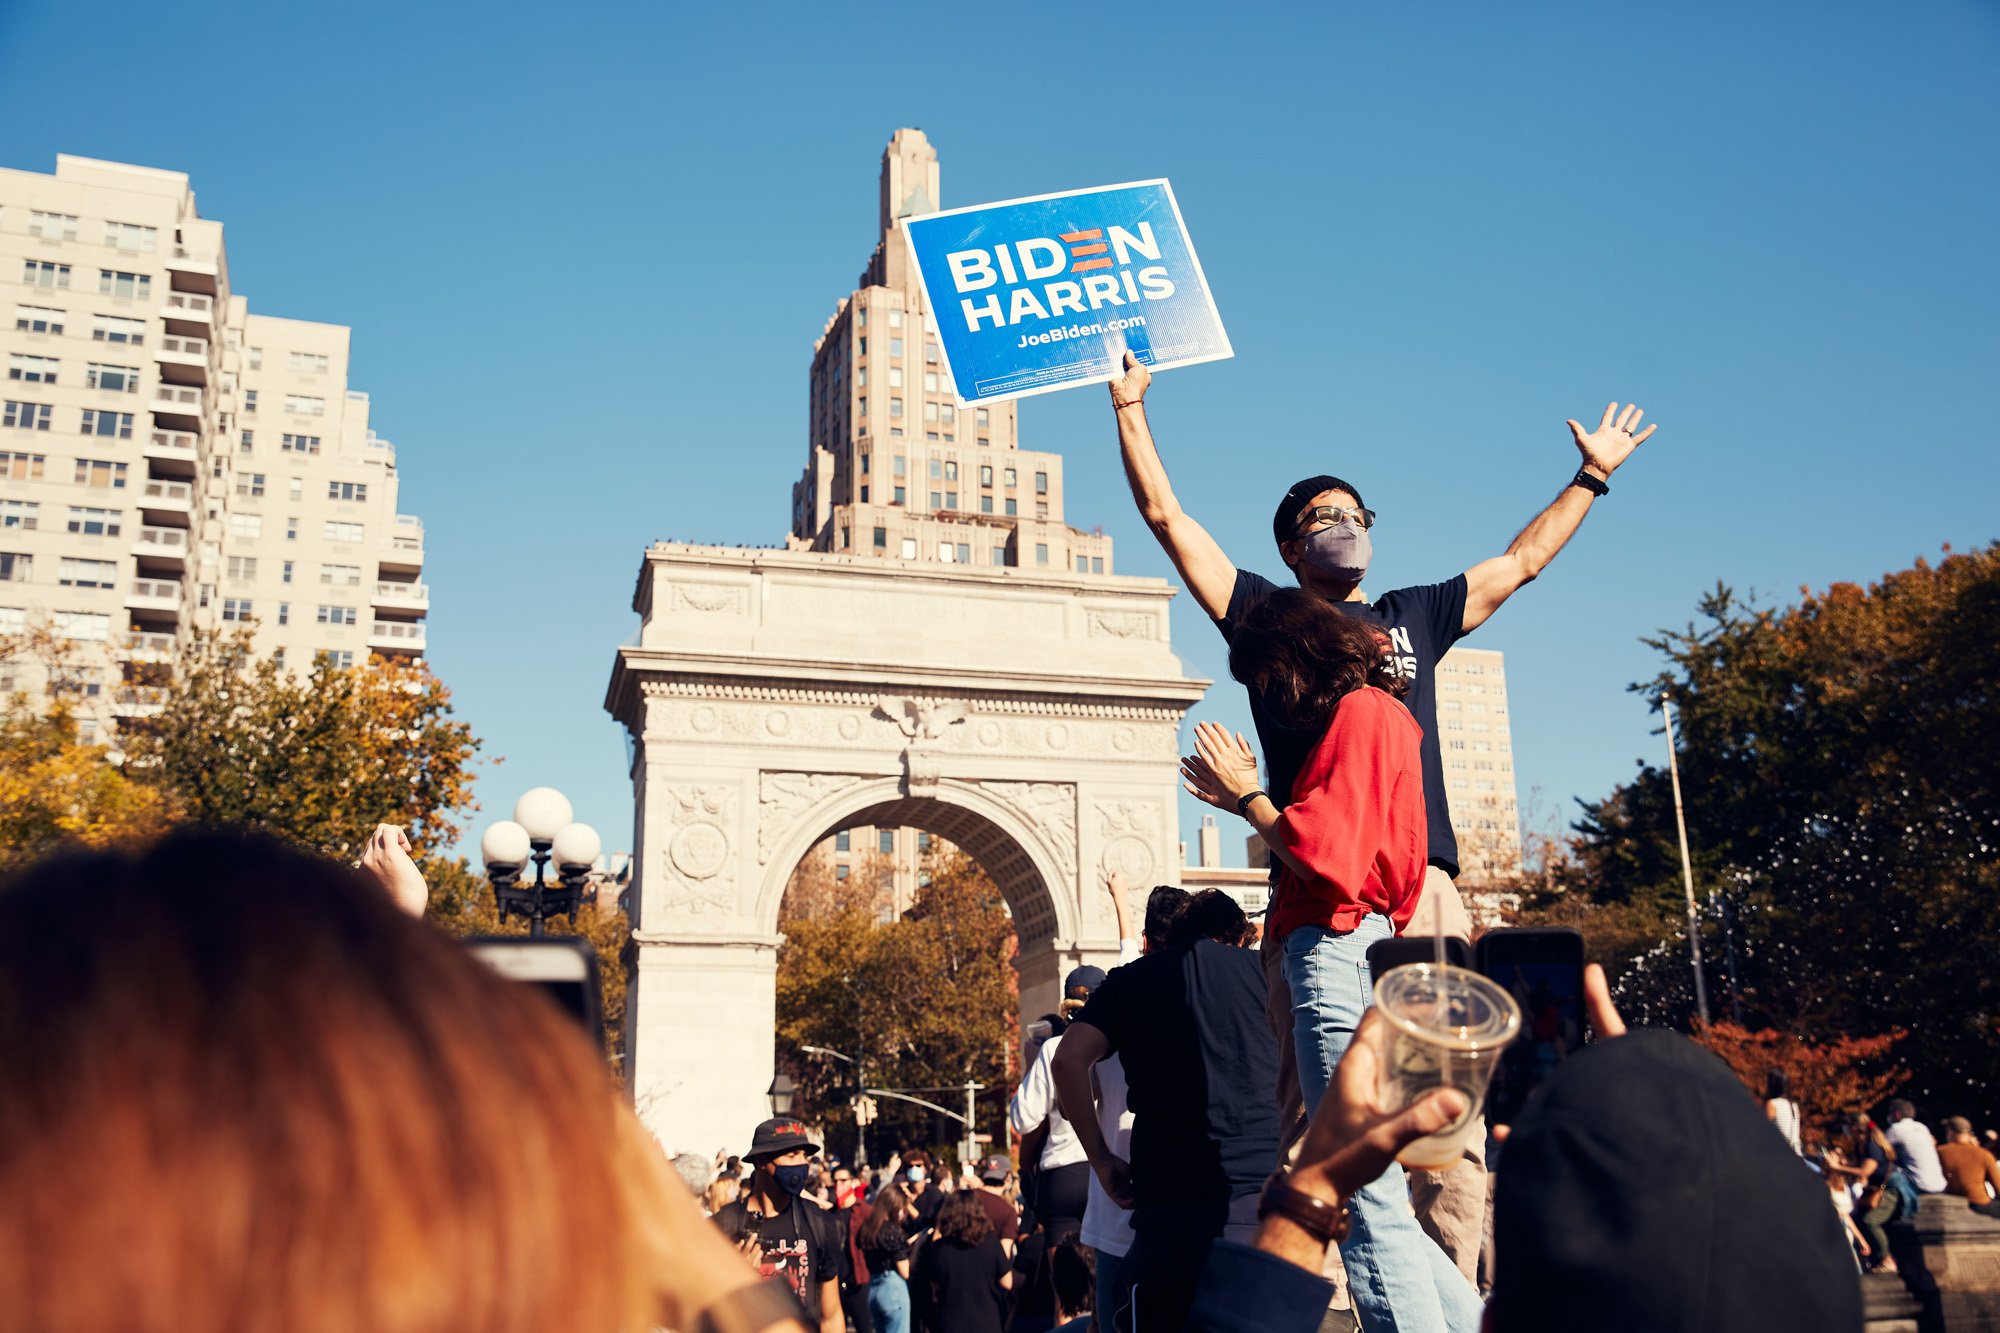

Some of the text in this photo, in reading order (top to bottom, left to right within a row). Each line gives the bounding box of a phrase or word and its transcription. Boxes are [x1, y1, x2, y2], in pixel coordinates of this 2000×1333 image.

[946, 222, 1161, 293] BIDEN
[961, 266, 1176, 333] HARRIS
[1017, 314, 1147, 349] JoeBiden.com
